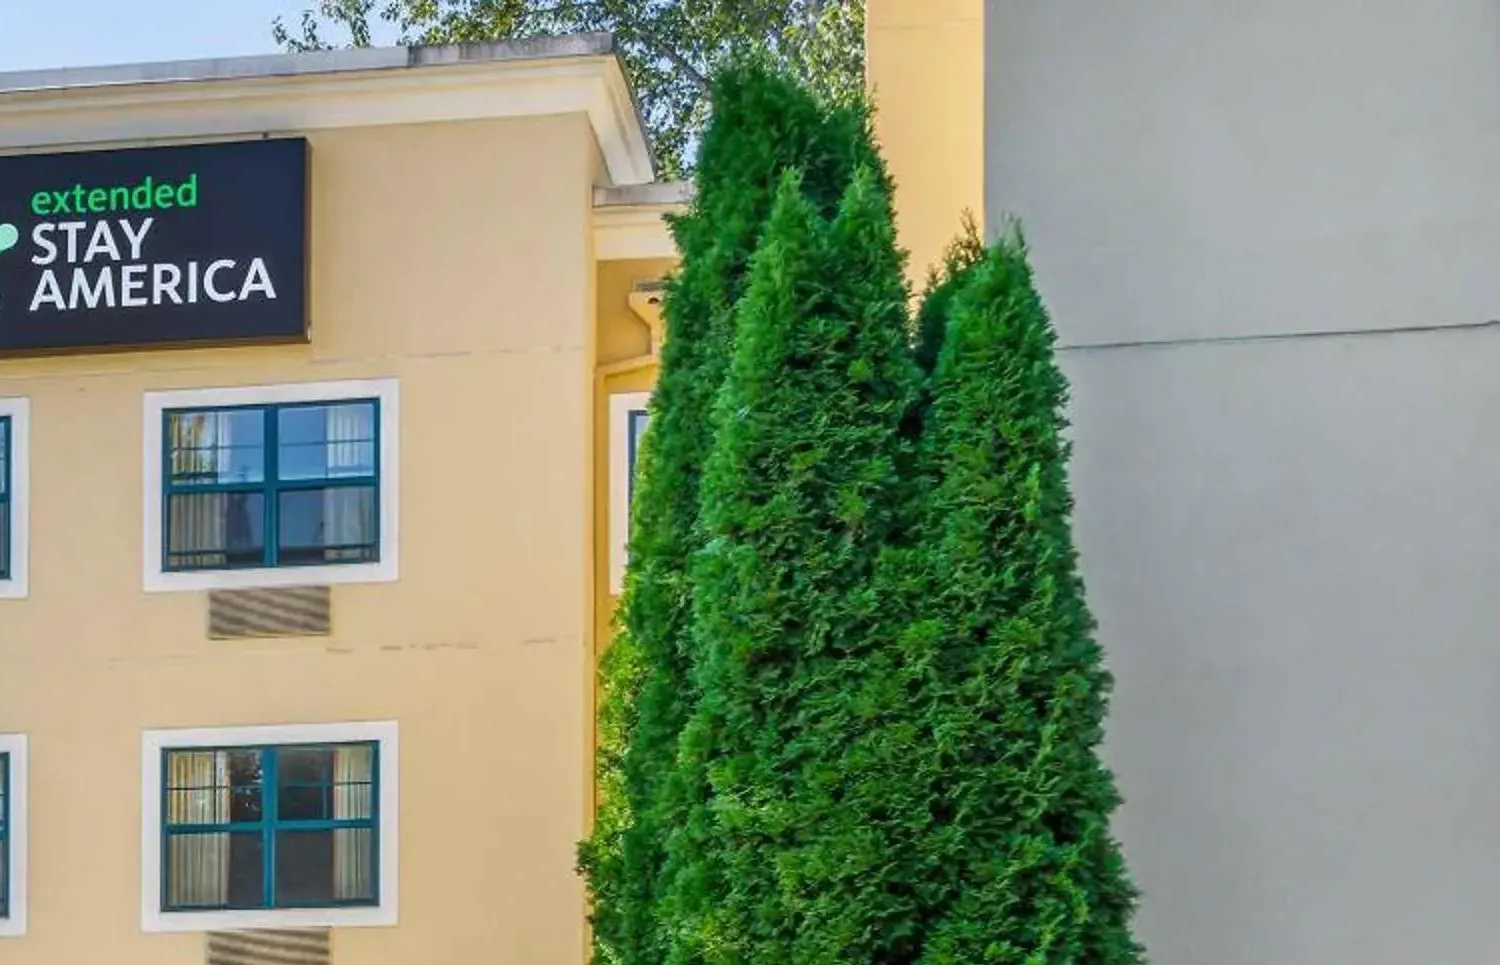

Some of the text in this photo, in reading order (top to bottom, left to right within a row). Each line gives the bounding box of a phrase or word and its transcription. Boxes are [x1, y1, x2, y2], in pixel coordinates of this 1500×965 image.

[31, 173, 197, 215] extended
[31, 217, 154, 266] STAY
[29, 256, 277, 312] AMERICA
